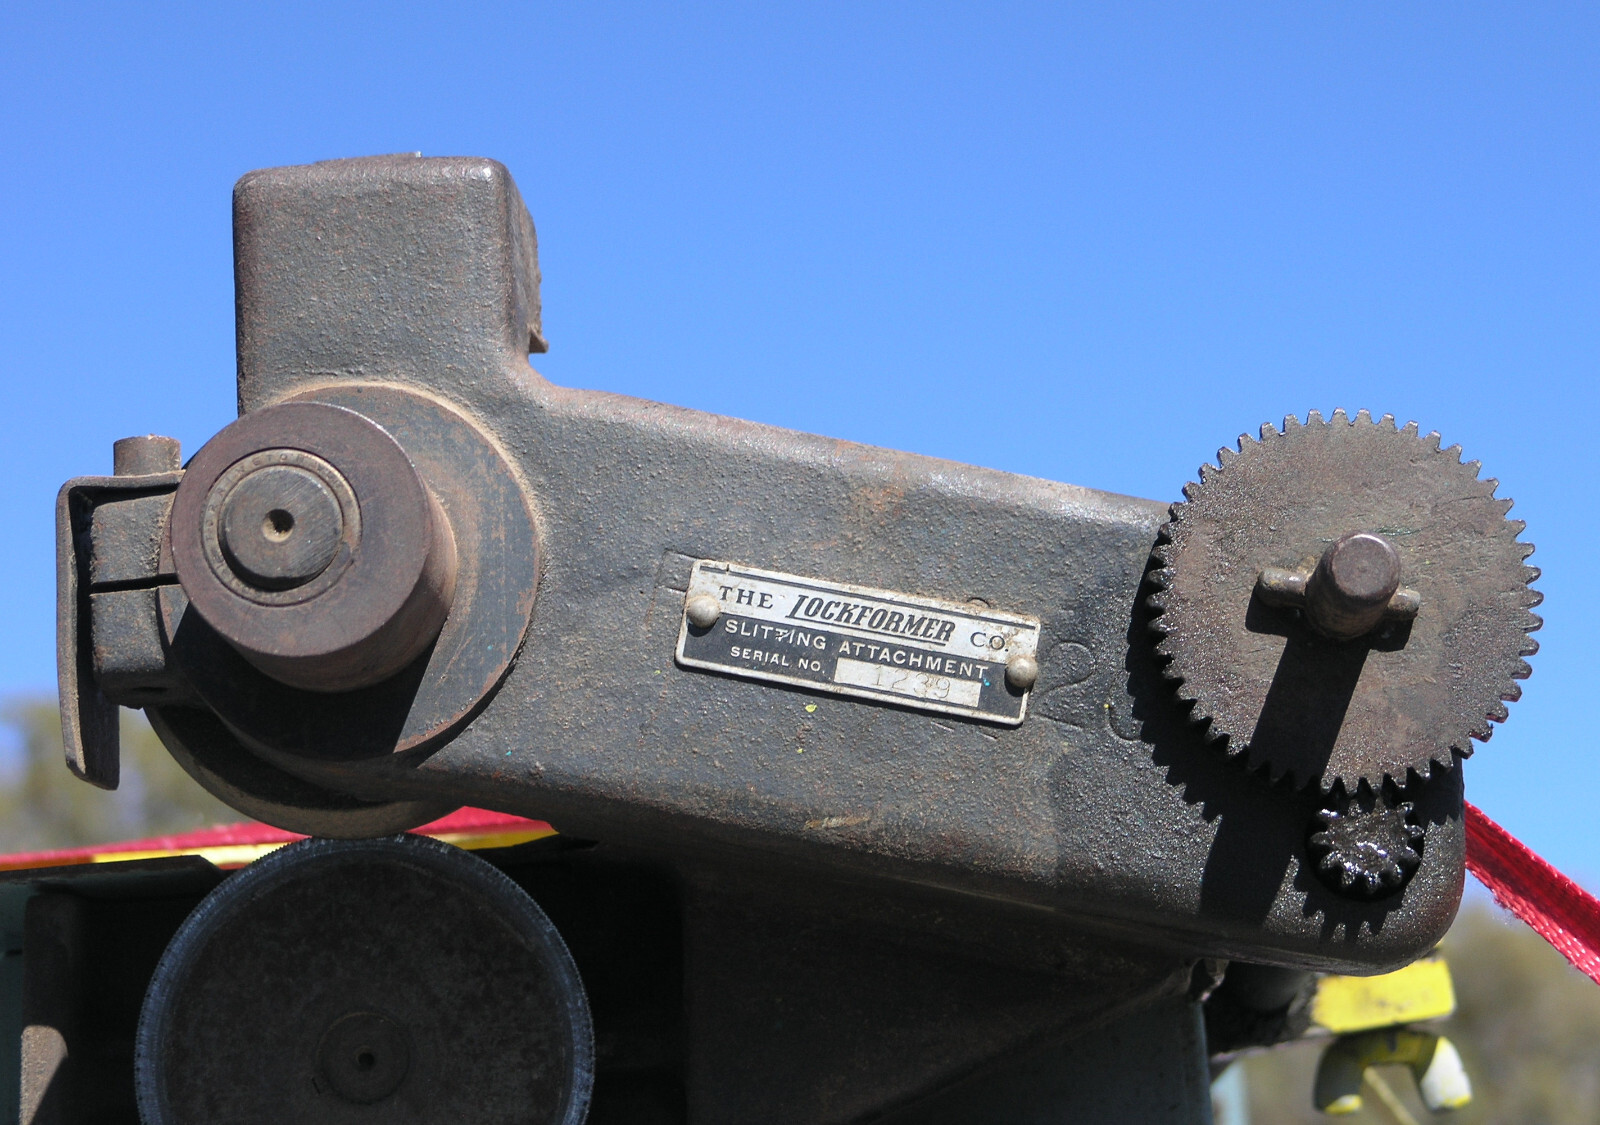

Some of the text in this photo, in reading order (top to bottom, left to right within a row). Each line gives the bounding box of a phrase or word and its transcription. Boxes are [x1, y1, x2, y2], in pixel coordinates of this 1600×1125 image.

[719, 585, 1010, 653] THE LOCKFORMER CO.
[724, 619, 989, 679] SLITTING ATTACHMENT
[730, 646, 951, 699] SERIAL NO. 1239
